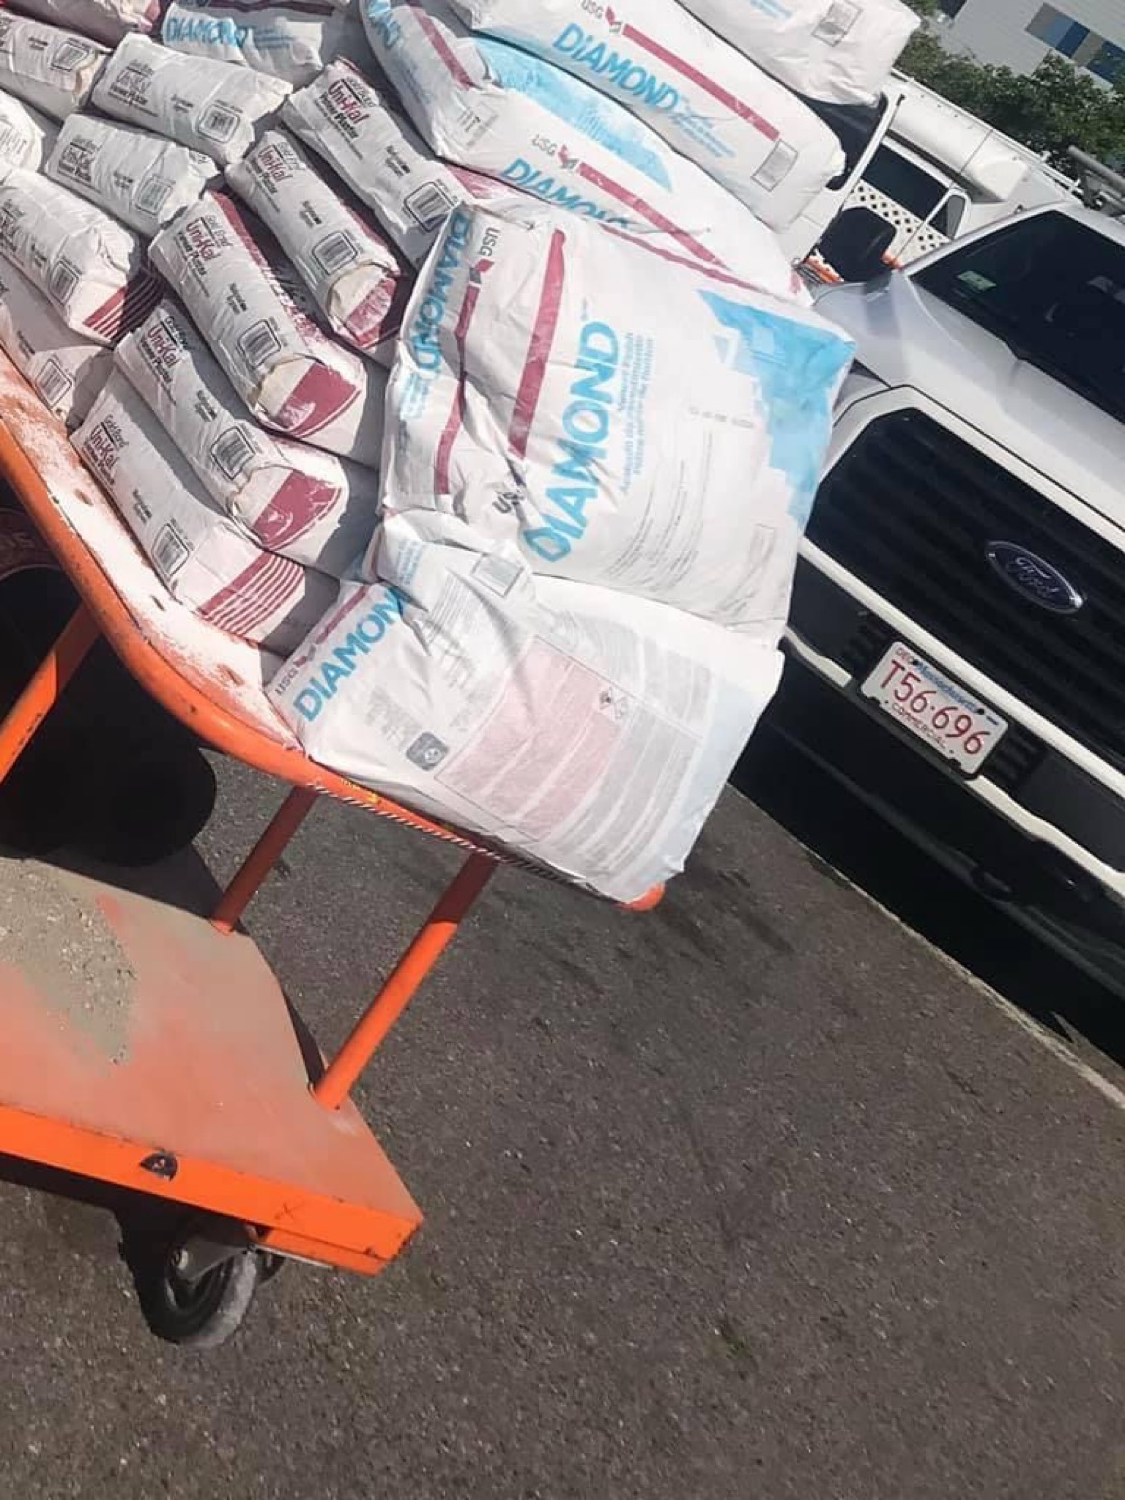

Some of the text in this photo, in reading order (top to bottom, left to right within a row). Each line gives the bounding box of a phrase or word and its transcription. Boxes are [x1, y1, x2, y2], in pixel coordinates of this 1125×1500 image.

[552, 22, 679, 111] DIAMOND
[531, 134, 558, 157] USG
[478, 227, 500, 257] USG
[412, 211, 469, 370] DIAMOND
[522, 321, 619, 563] DIAMOND
[275, 667, 299, 695] USG
[891, 702, 946, 750] COMMERCIAL
